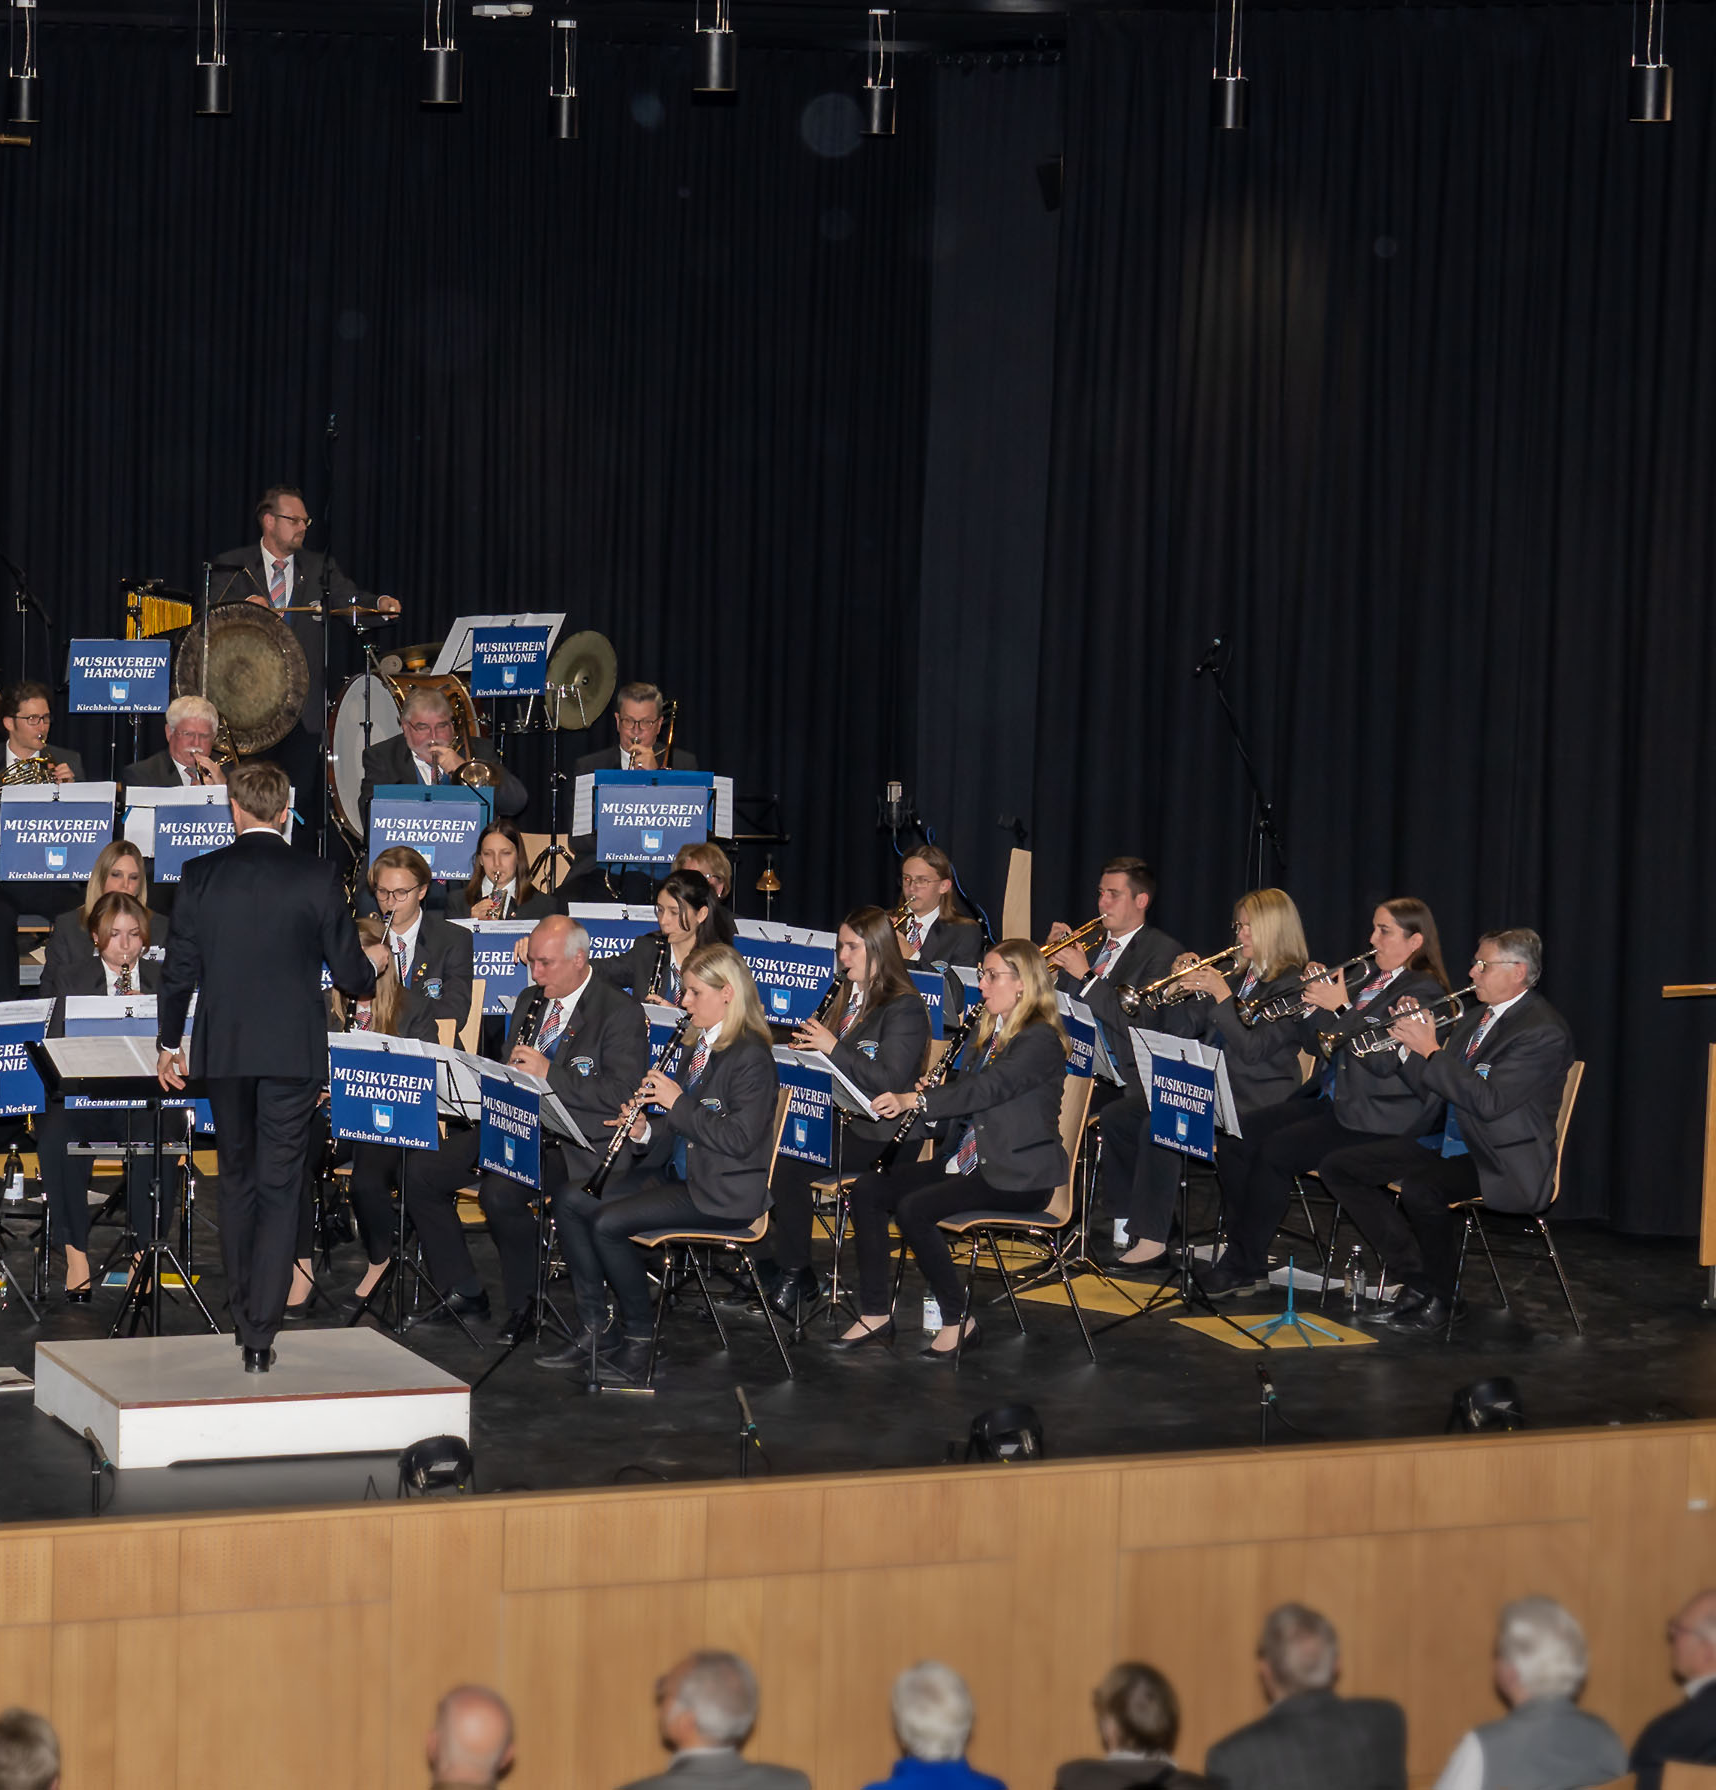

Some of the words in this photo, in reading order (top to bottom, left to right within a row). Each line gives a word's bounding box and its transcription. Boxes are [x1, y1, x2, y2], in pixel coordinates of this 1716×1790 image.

[474, 641, 546, 653] MUSIKVEREIN
[73, 656, 167, 667] MUSIKVEREIN
[483, 653, 537, 664] HARMONIE
[84, 668, 156, 679] HARMONIE
[601, 803, 704, 815] MUSIKVEREIN
[4, 820, 109, 831] MUSIKVEREIN
[373, 818, 477, 831] MUSIKVEREIN
[613, 815, 692, 827] HARMONIE
[158, 823, 236, 834] MUSIKVER
[16, 832, 97, 843] HARMONIE
[171, 835, 236, 846] HARMON
[385, 830, 465, 843] HARMONIE
[605, 853, 650, 861] Kirchheim
[8, 871, 54, 879] Kirchheim
[440, 870, 471, 878] Neckar
[743, 956, 831, 978] USIKVEREIN
[334, 1067, 434, 1091] MUSIKVEREIN
[1153, 1074, 1213, 1102] MUSIKVEREIN
[345, 1084, 422, 1105] HARMONIE
[1160, 1090, 1206, 1115] HARMONIE
[5, 1104, 37, 1114] Neckar
[482, 1095, 538, 1127] MUSIKVEREIN
[489, 1112, 531, 1140] HARMONIE
[339, 1128, 382, 1142] Kirchheim
[383, 1135, 397, 1144] am
[399, 1136, 430, 1148] Neckar
